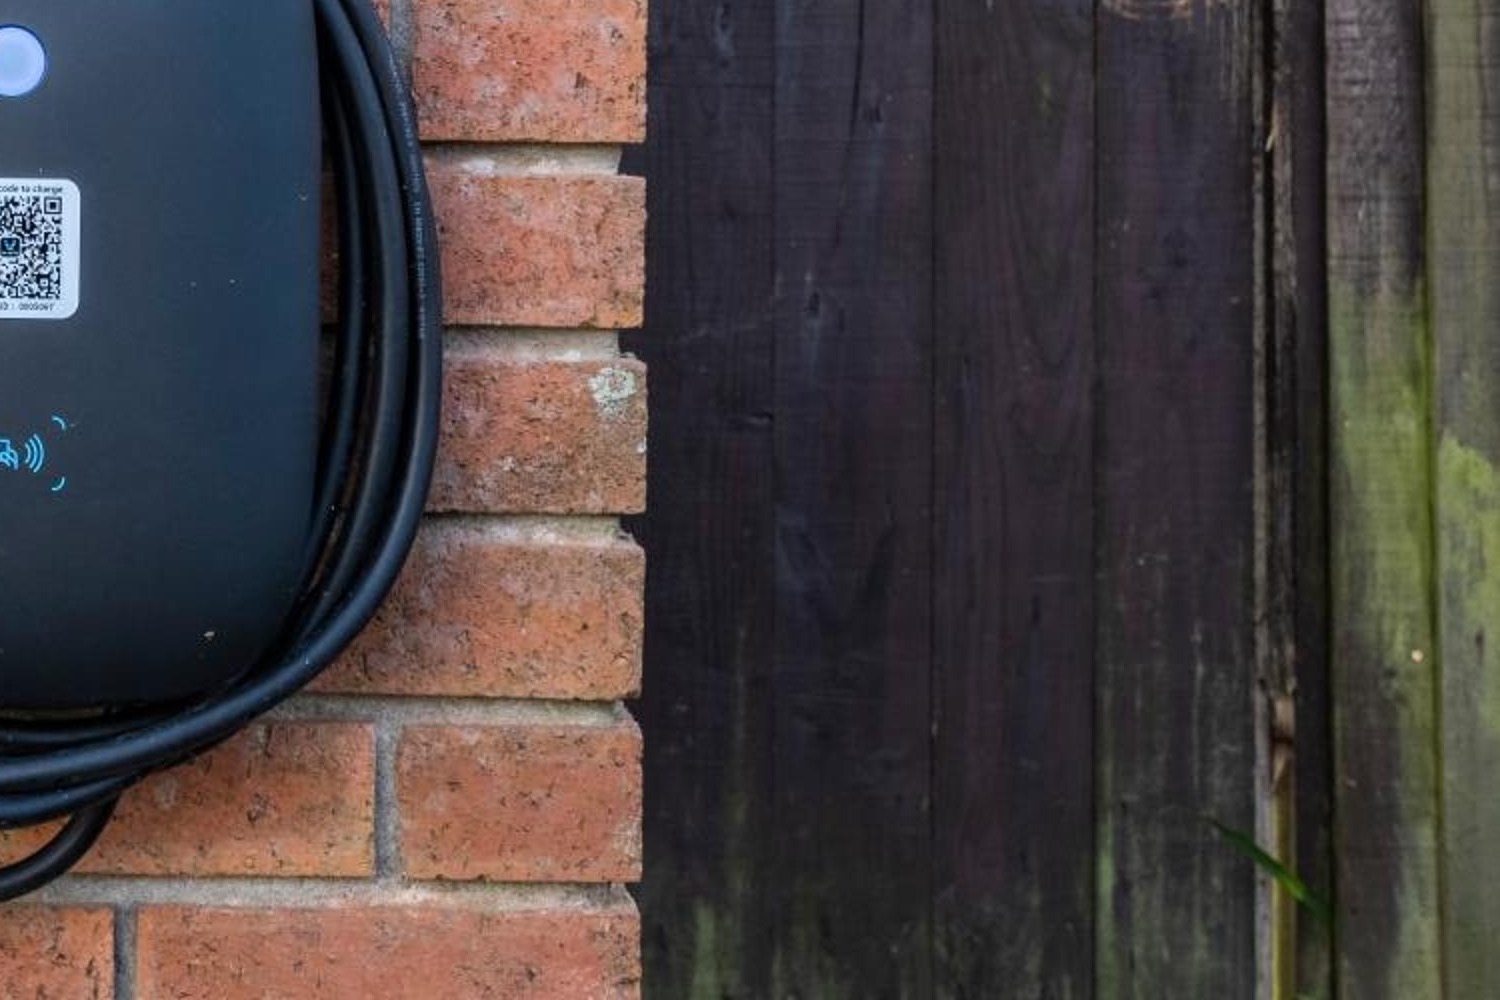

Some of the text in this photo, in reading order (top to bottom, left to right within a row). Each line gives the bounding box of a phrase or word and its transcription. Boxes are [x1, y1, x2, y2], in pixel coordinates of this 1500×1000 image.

[0, 184, 18, 193] code
[22, 184, 30, 193] to
[33, 185, 63, 194] charge
[0, 302, 9, 310] ID
